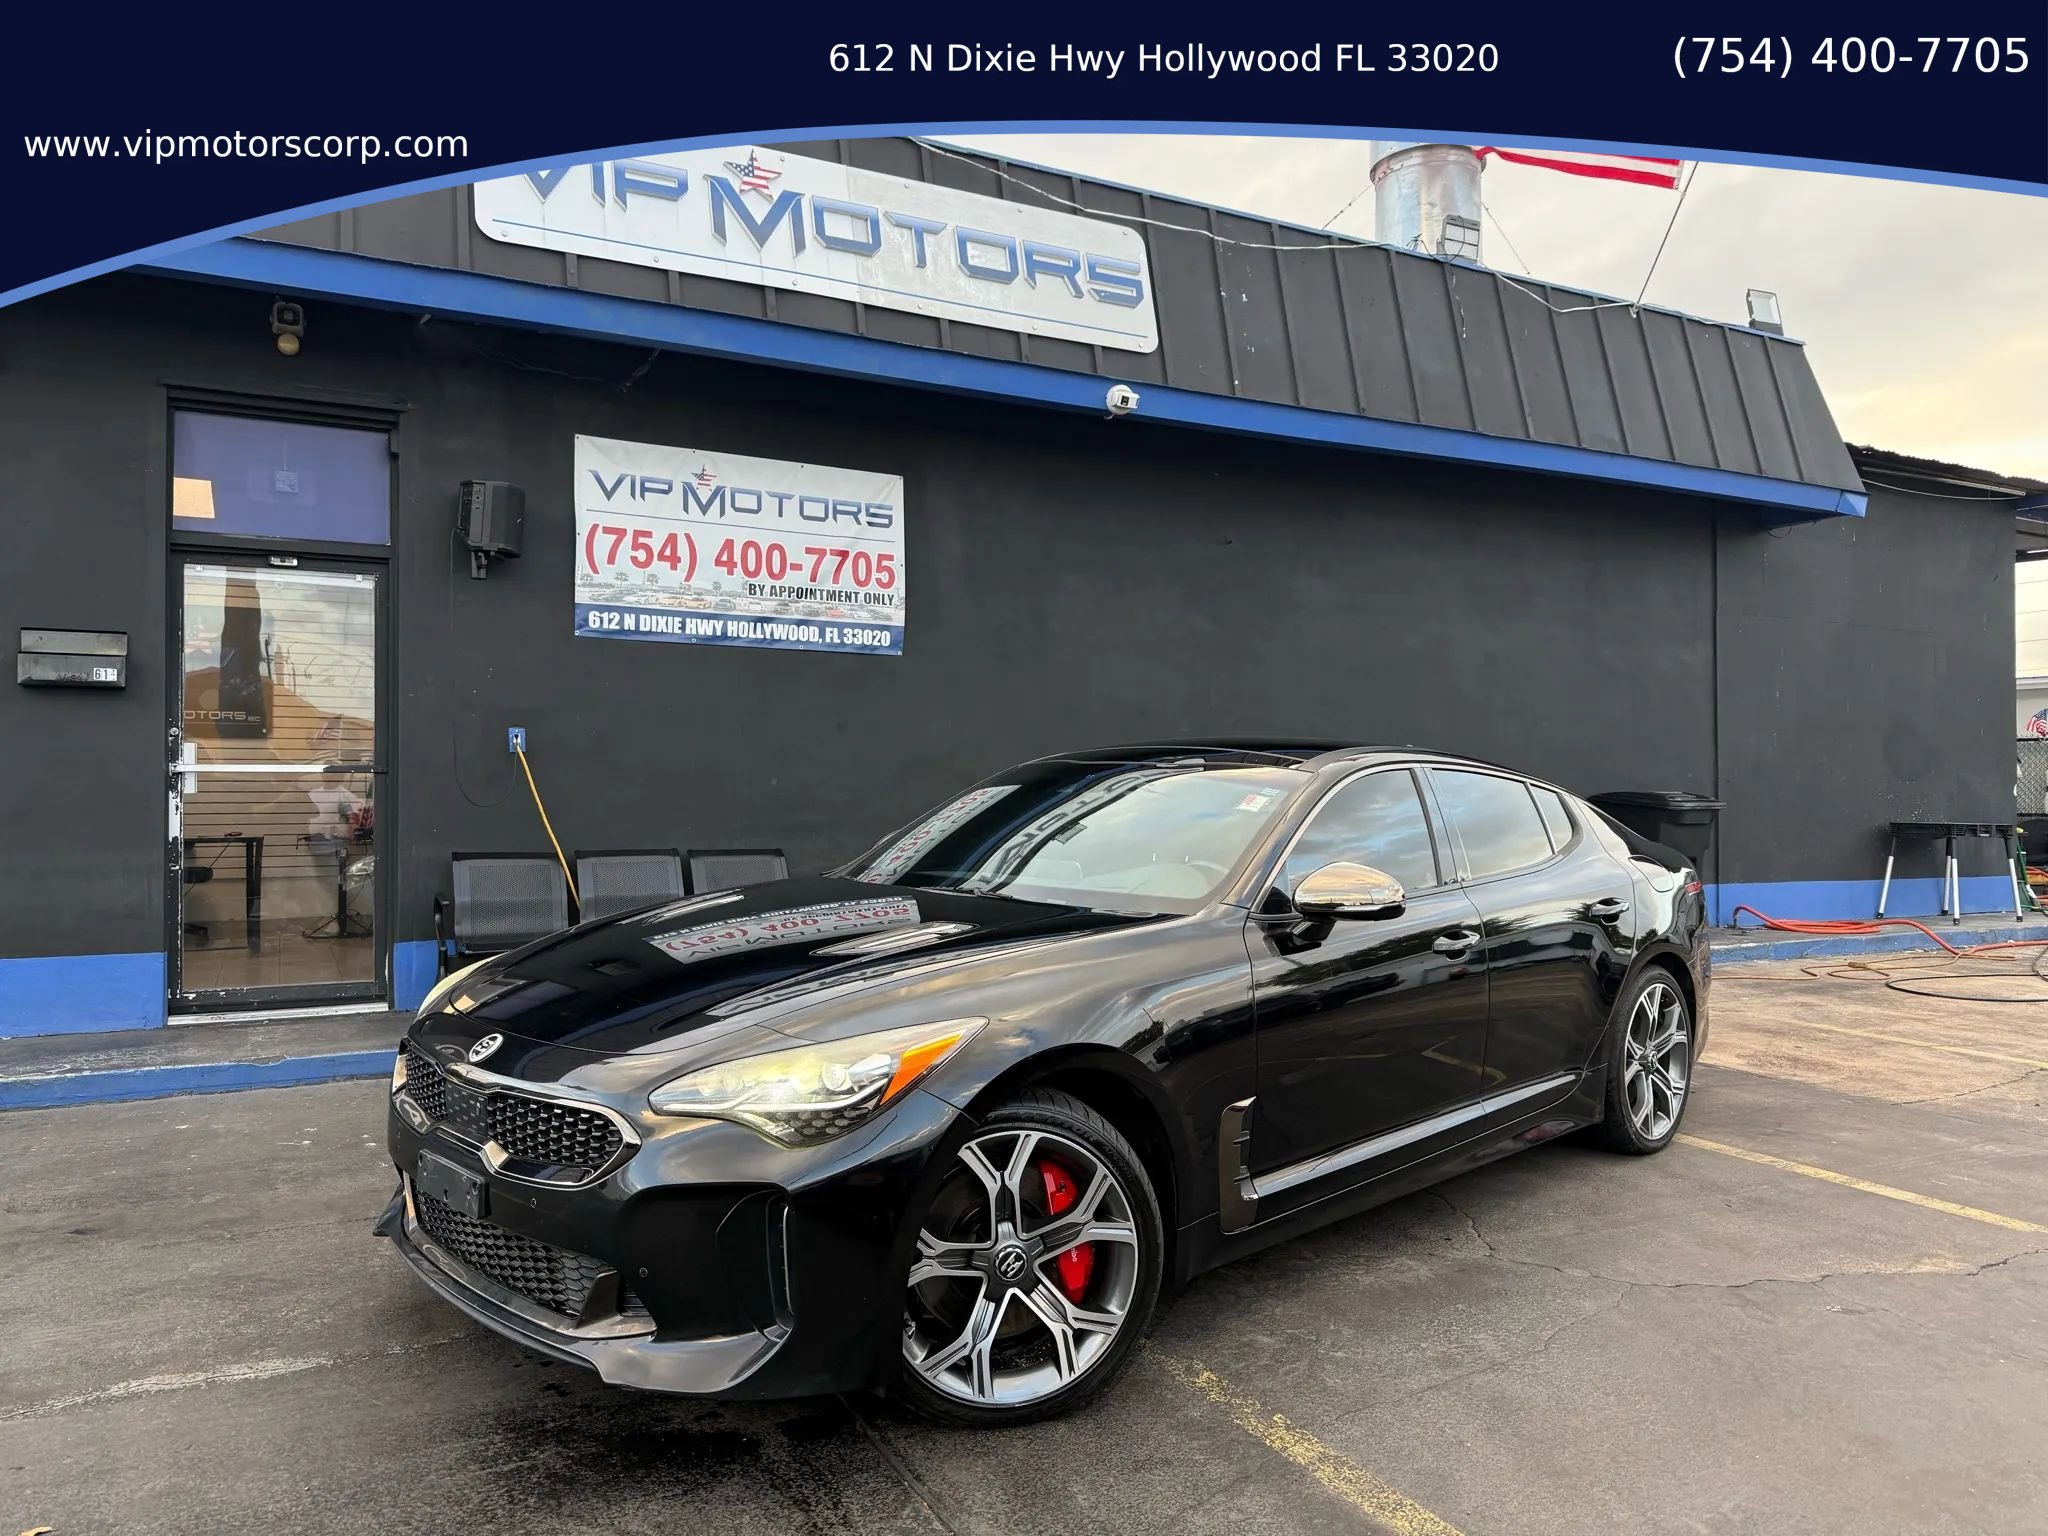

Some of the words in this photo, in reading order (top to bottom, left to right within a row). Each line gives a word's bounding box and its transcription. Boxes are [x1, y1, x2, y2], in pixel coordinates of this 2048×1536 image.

[703, 172, 1146, 309] MOTORS
[587, 469, 674, 502] VIP
[681, 480, 894, 529] MOTORS
[585, 523, 698, 583] (754)
[713, 538, 896, 589] 400-7705
[748, 583, 767, 597] BY
[768, 583, 861, 604] APPOINTMENT
[862, 591, 895, 606] ONLY
[588, 610, 620, 630] 612
[624, 613, 636, 630] N
[639, 614, 682, 634] DIXIE
[685, 619, 725, 636] HWY
[825, 627, 841, 643] FL
[843, 626, 891, 647] 33020
